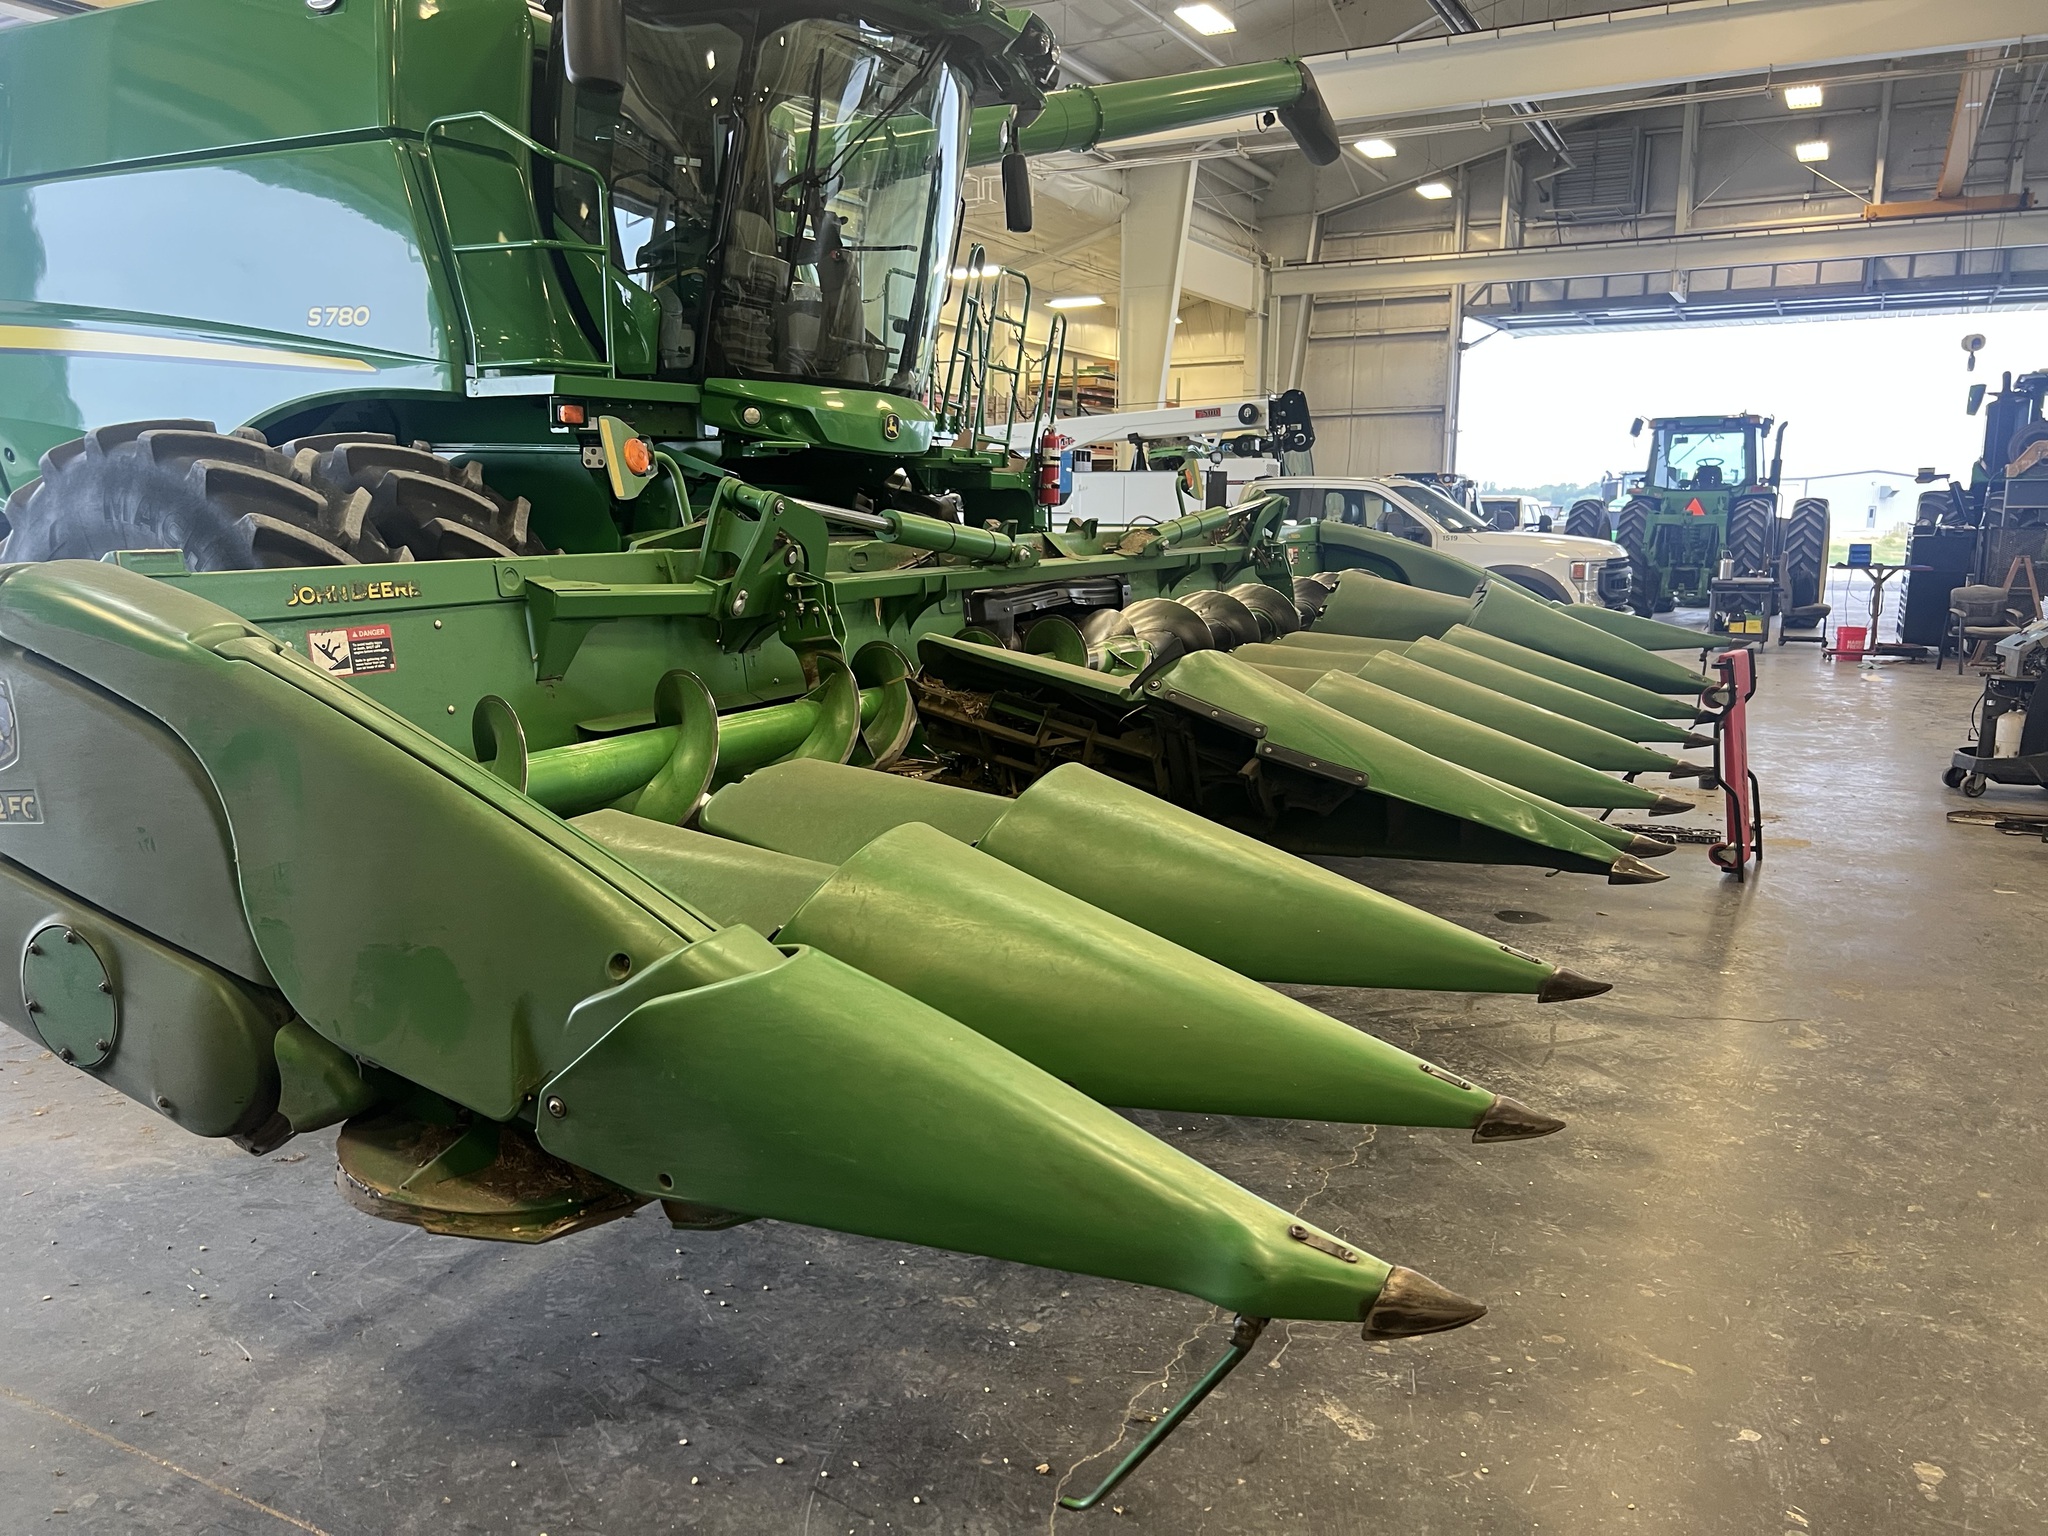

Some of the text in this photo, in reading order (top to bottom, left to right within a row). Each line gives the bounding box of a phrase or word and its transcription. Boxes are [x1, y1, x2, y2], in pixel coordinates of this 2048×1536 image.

[307, 305, 371, 328] S780
[287, 580, 422, 607] JOHN DEERE
[358, 628, 386, 638] DANGER
